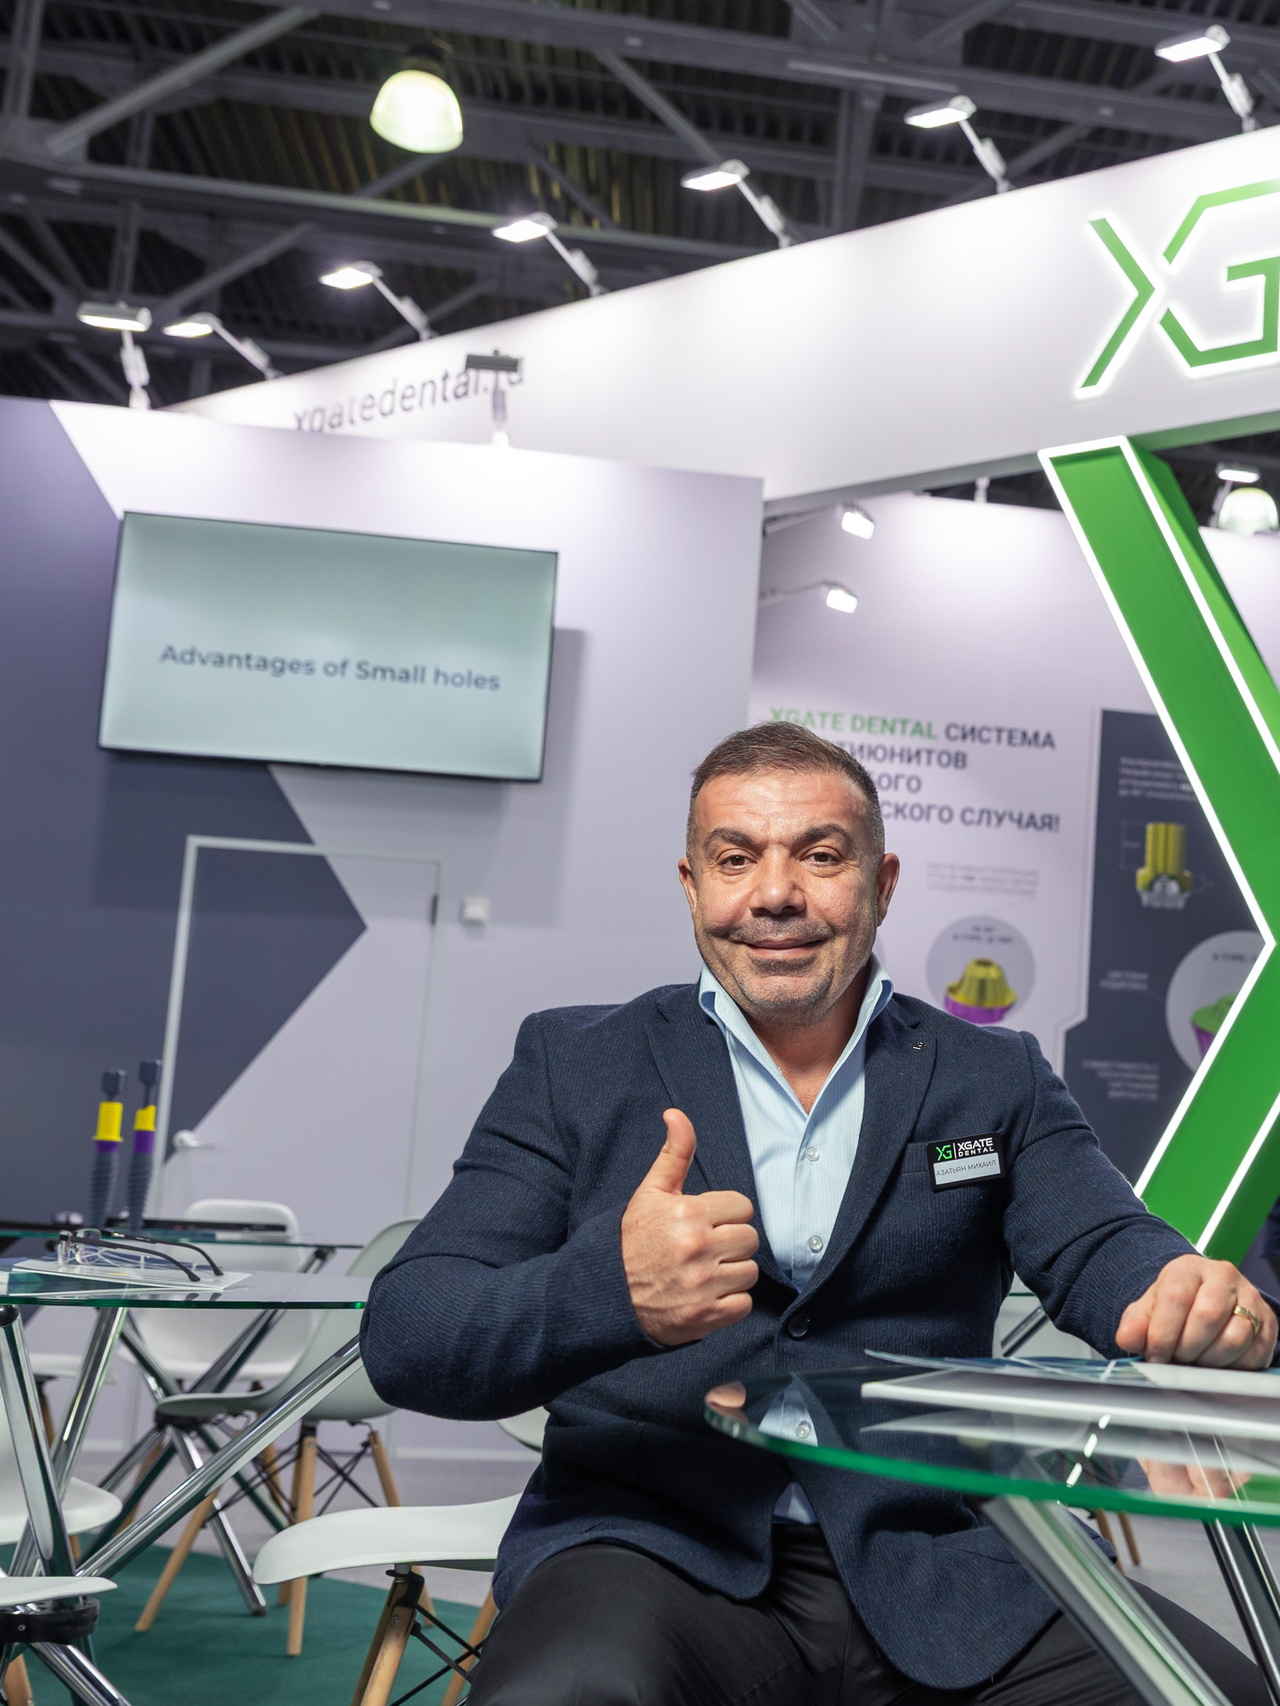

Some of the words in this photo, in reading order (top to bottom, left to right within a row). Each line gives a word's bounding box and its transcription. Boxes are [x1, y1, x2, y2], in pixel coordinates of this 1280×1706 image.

[159, 644, 315, 677] Advantages
[323, 657, 351, 678] of
[356, 660, 427, 685] Small
[433, 668, 501, 692] holes
[771, 706, 845, 732] XGATE
[851, 714, 939, 740] DENTAL
[944, 722, 1056, 750] СИСТЕМА
[835, 741, 968, 770] ИЮНИТОВ
[874, 771, 922, 795] ОГО
[880, 800, 955, 825] СКОГО
[960, 806, 1061, 834] СЛУЧАЯ!
[957, 1137, 994, 1152] XGATE
[958, 1146, 995, 1158] DENTAL
[967, 1160, 997, 1172] МИХАИЛ
